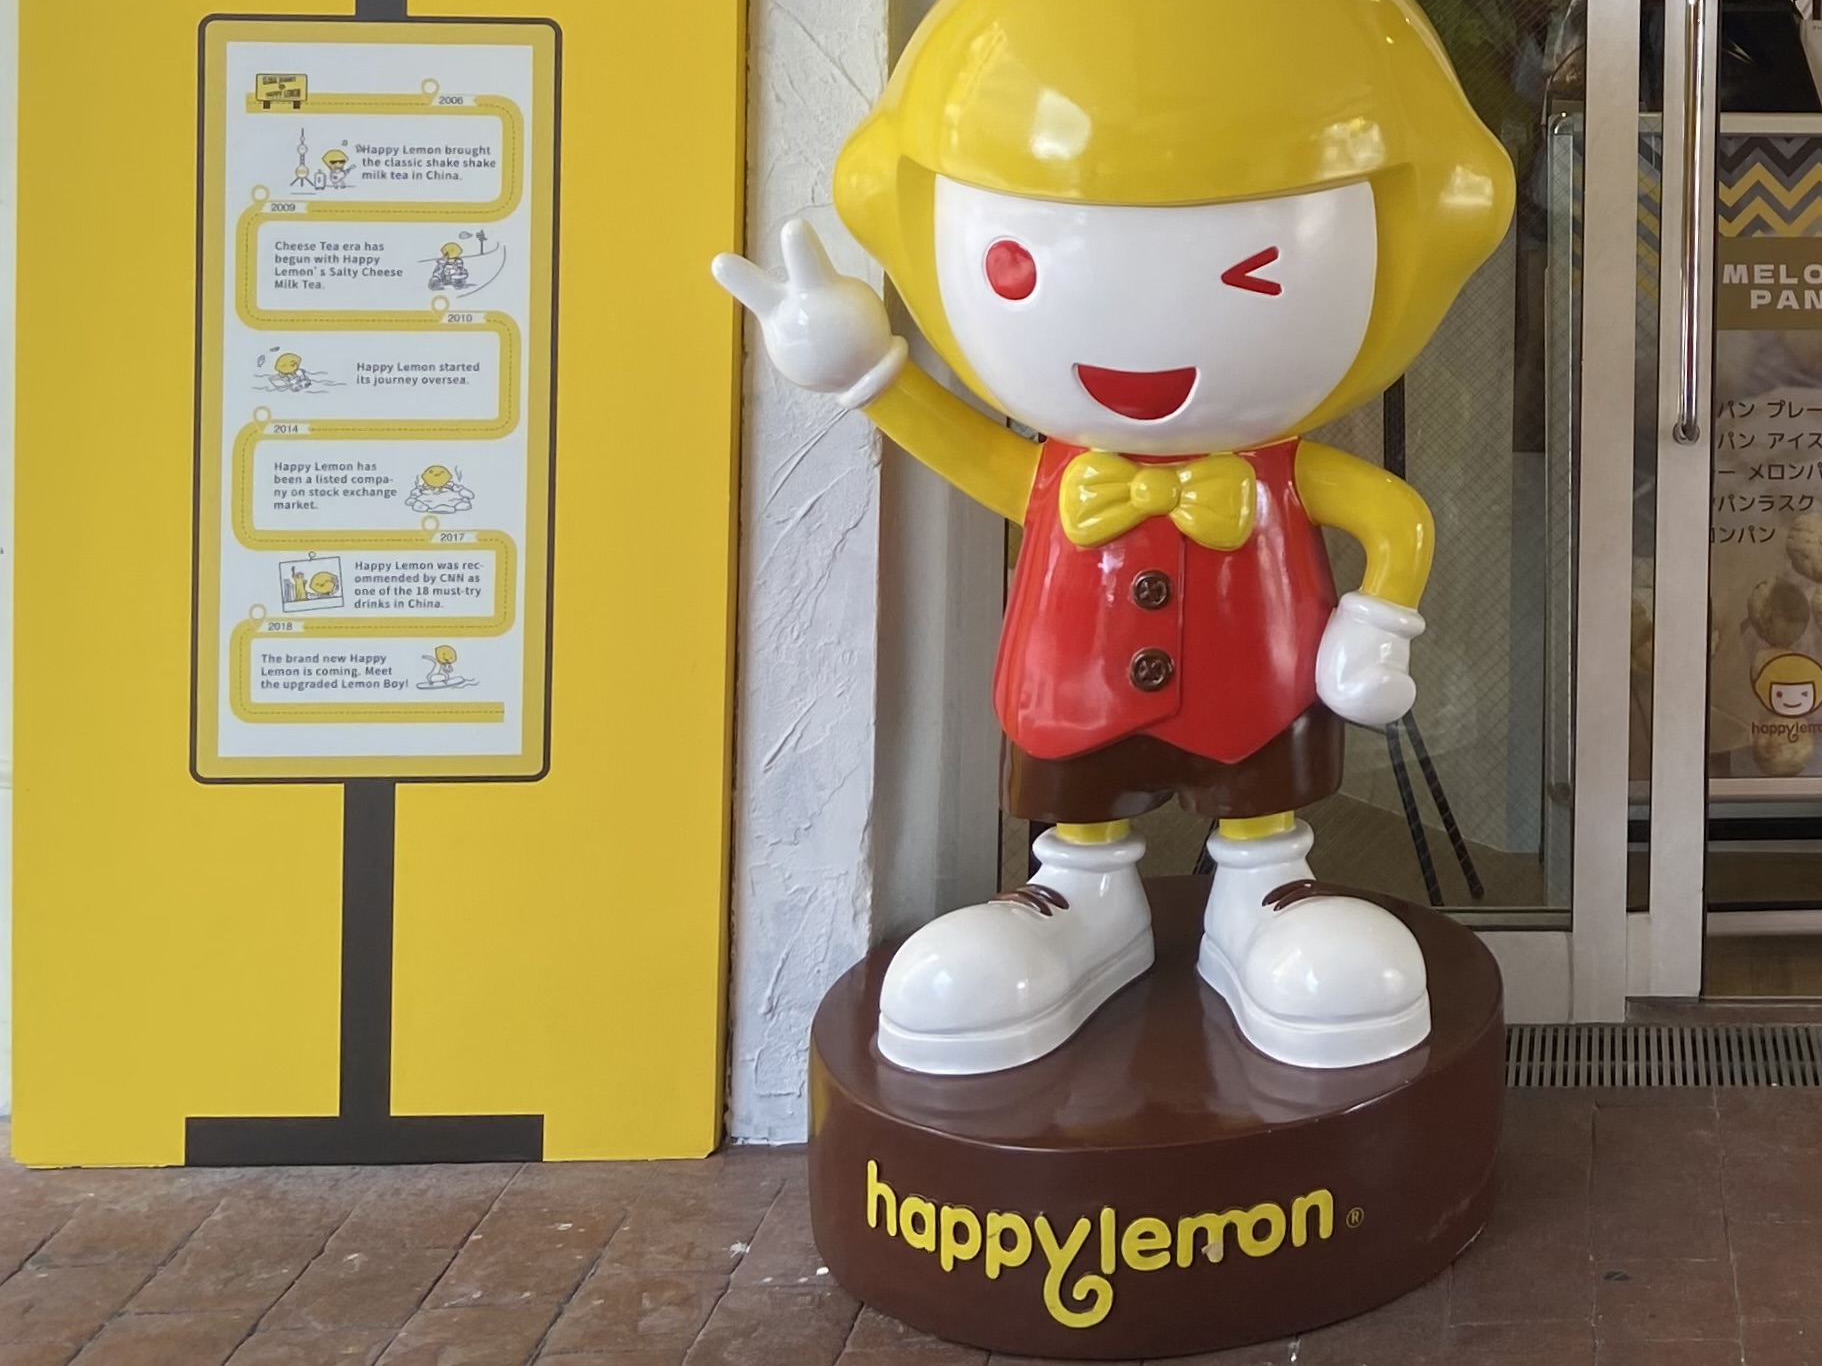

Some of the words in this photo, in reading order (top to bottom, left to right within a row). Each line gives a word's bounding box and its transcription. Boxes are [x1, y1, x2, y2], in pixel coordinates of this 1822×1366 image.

[438, 95, 464, 105] 2006
[361, 144, 400, 157] Happy
[402, 144, 442, 155] Lemon
[444, 144, 491, 157] brought
[362, 156, 382, 168] the
[384, 157, 423, 168] classic
[425, 157, 460, 168] shake
[462, 157, 496, 169] shake
[361, 169, 387, 180] milk
[390, 171, 409, 181] tea
[411, 170, 423, 181] in
[425, 169, 462, 181] China.
[270, 202, 296, 212] 2009
[274, 240, 317, 252] Cheese
[319, 241, 340, 252] Tea
[342, 243, 361, 252] era
[364, 241, 385, 252] has
[274, 253, 311, 267] begun
[313, 253, 340, 264] with
[342, 254, 381, 267] Happy
[329, 266, 359, 280] Salty
[361, 266, 404, 278] Cheese
[274, 279, 299, 290] Milk
[447, 313, 473, 324] 2010
[356, 362, 394, 374] Happy
[396, 361, 436, 372] Lemon
[438, 361, 481, 372] started
[356, 374, 371, 385] its
[372, 375, 419, 387] journey
[420, 376, 470, 385] oversea.
[273, 424, 299, 435] 2014
[273, 461, 312, 474] Happy
[314, 461, 354, 472] Lemon
[356, 460, 377, 472] has
[273, 473, 303, 485] been
[305, 476, 313, 485] a
[315, 473, 348, 485] listed
[350, 476, 394, 487] compa-
[273, 489, 288, 500] ny
[290, 488, 306, 497] on
[308, 486, 340, 498] stock
[342, 486, 398, 500] exchange
[273, 499, 318, 510] market.
[1713, 493, 1815, 513] パンラスク
[439, 532, 465, 543] 2017
[354, 560, 392, 573] Happy
[395, 561, 434, 571] Lemon
[436, 562, 460, 571] was
[353, 572, 420, 584] ommended
[422, 572, 437, 586] by
[439, 573, 465, 583] CNN
[467, 574, 481, 583] as
[354, 588, 376, 596] one
[378, 585, 391, 596] of
[393, 585, 413, 596] the
[416, 585, 430, 596] 18
[432, 586, 482, 598] must-try
[353, 598, 391, 609] drinks
[393, 598, 405, 609] in
[407, 598, 444, 609] China.
[267, 621, 293, 632] 2018
[261, 653, 283, 664] The
[285, 652, 320, 664] brand
[322, 655, 347, 664] new
[349, 653, 387, 666] Happy
[260, 666, 300, 677] Lemon
[302, 666, 313, 677] is
[315, 666, 362, 679] coming.
[364, 665, 393, 676] Meet
[260, 679, 281, 690] the
[282, 678, 338, 692] upgraded
[341, 679, 381, 689] Lemon
[383, 678, 409, 691] Boy!
[866, 1159, 1334, 1328] happylemon
